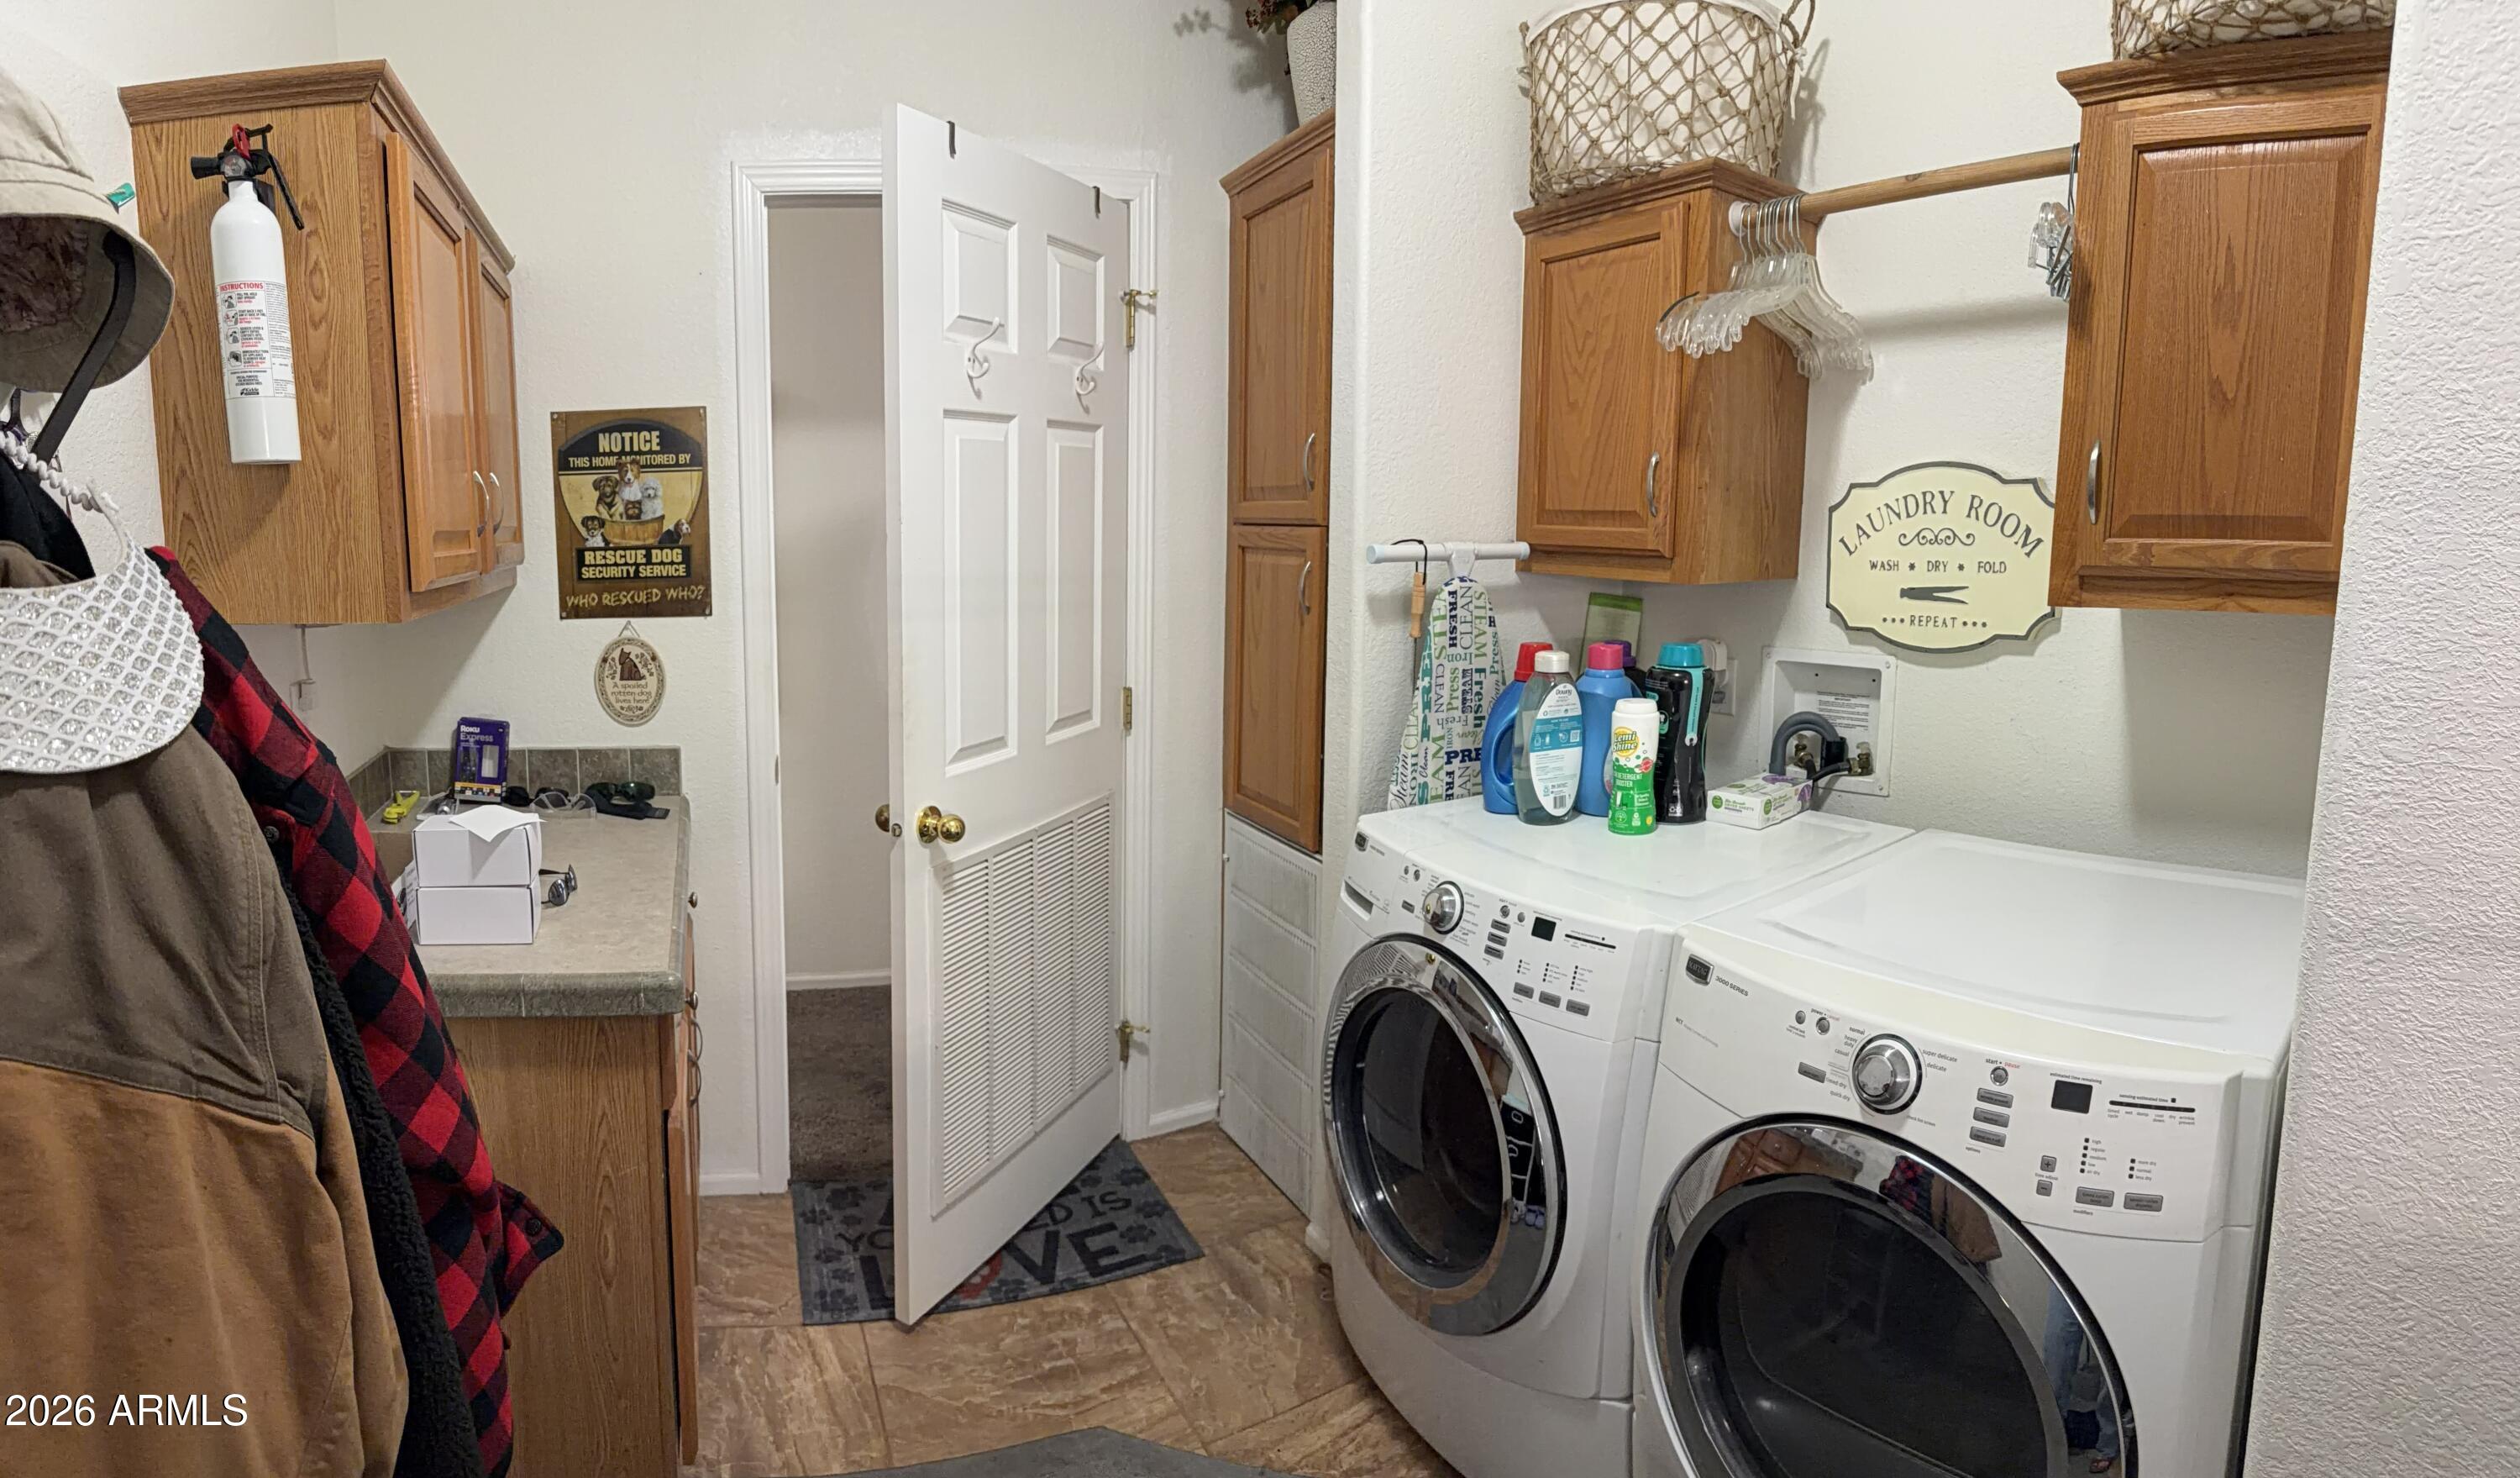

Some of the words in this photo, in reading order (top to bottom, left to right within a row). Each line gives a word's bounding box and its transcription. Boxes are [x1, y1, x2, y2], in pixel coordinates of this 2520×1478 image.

[219, 282, 264, 292] INSTRUCTIONS
[598, 430, 661, 453] NOTICE
[568, 457, 590, 468] THIS
[679, 454, 690, 464] BY
[1839, 490, 1955, 556] LAUNDRY
[1966, 494, 2045, 558] ROOM
[584, 550, 647, 565] RESCUE
[651, 549, 683, 563] DOG
[581, 565, 636, 579] SECURITY
[638, 565, 686, 577] SERVICE
[1869, 560, 1899, 571] WASH
[1927, 560, 1949, 572] DRY
[1977, 561, 2007, 574] FOLD
[566, 592, 598, 608] WHO
[602, 588, 661, 607] RESCUED
[664, 585, 706, 601] WHO?
[1447, 589, 1458, 649] FRESH
[1460, 586, 1473, 650] CLEAN
[1474, 590, 1488, 659] STEAM
[1909, 615, 1958, 629] REPEAT
[1446, 652, 1474, 665] Iron
[1490, 631, 1499, 676] Press
[621, 681, 648, 690] spoiled
[1434, 663, 1446, 713] CLEAN
[1446, 667, 1460, 713] Press
[1462, 667, 1473, 714] STEAM
[638, 689, 652, 699] dog
[1473, 668, 1487, 728] Fresh
[1437, 715, 1468, 730] Fresh
[460, 733, 494, 742] Express
[1614, 731, 1637, 741] Lemi
[1613, 741, 1637, 752] Shine
[1419, 746, 1429, 779] Clean
[1410, 753, 1419, 806] IRON
[1688, 960, 1708, 975] MAYTAG
[1715, 976, 1729, 986] 3000
[1730, 983, 1749, 997] SERIES
[1849, 1026, 1865, 1035] normal
[1844, 1034, 1858, 1044] heavy
[1835, 1048, 1850, 1056] casual
[1923, 1049, 1937, 1058] super
[1937, 1052, 1957, 1063] delicate
[1927, 1062, 1946, 1072] delicate
[2004, 1061, 2021, 1070] pause
[1081, 1191, 1131, 1218] IS
